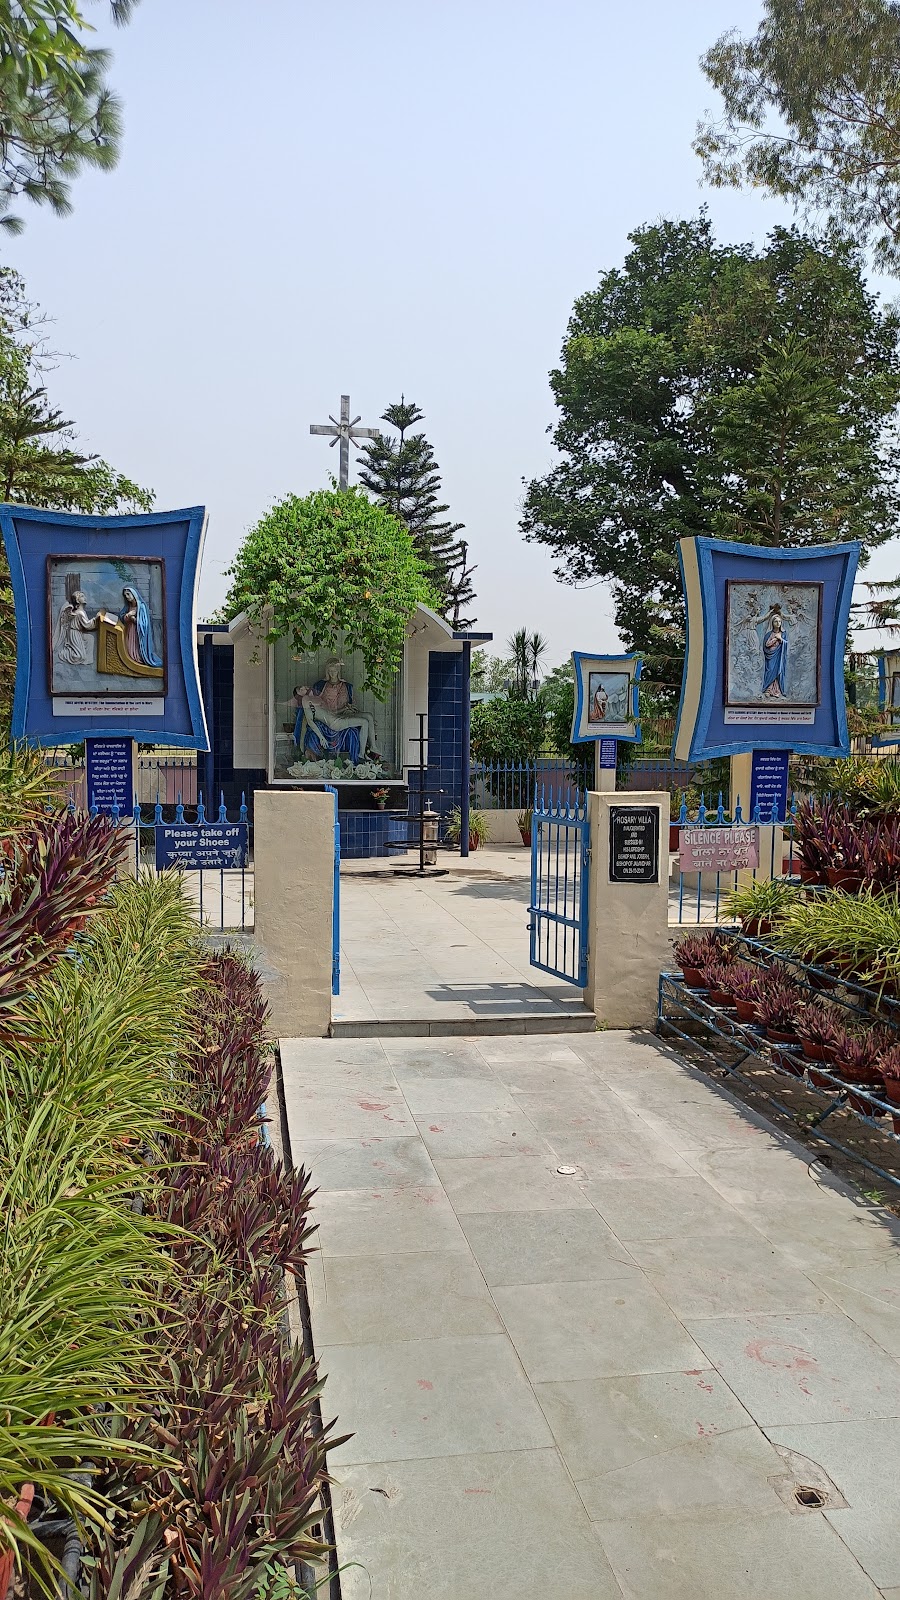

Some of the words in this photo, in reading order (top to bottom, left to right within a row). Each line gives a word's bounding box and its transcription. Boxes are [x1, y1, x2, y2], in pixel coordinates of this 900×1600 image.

[164, 829, 198, 838] Please
[201, 828, 222, 837] take
[226, 828, 239, 836] off
[685, 832, 720, 844] SILENCE
[724, 830, 756, 844] PLEASE
[174, 840, 196, 848] your
[199, 838, 229, 846] Shoes
[196, 848, 219, 857] अपने
[222, 848, 238, 858] जूते
